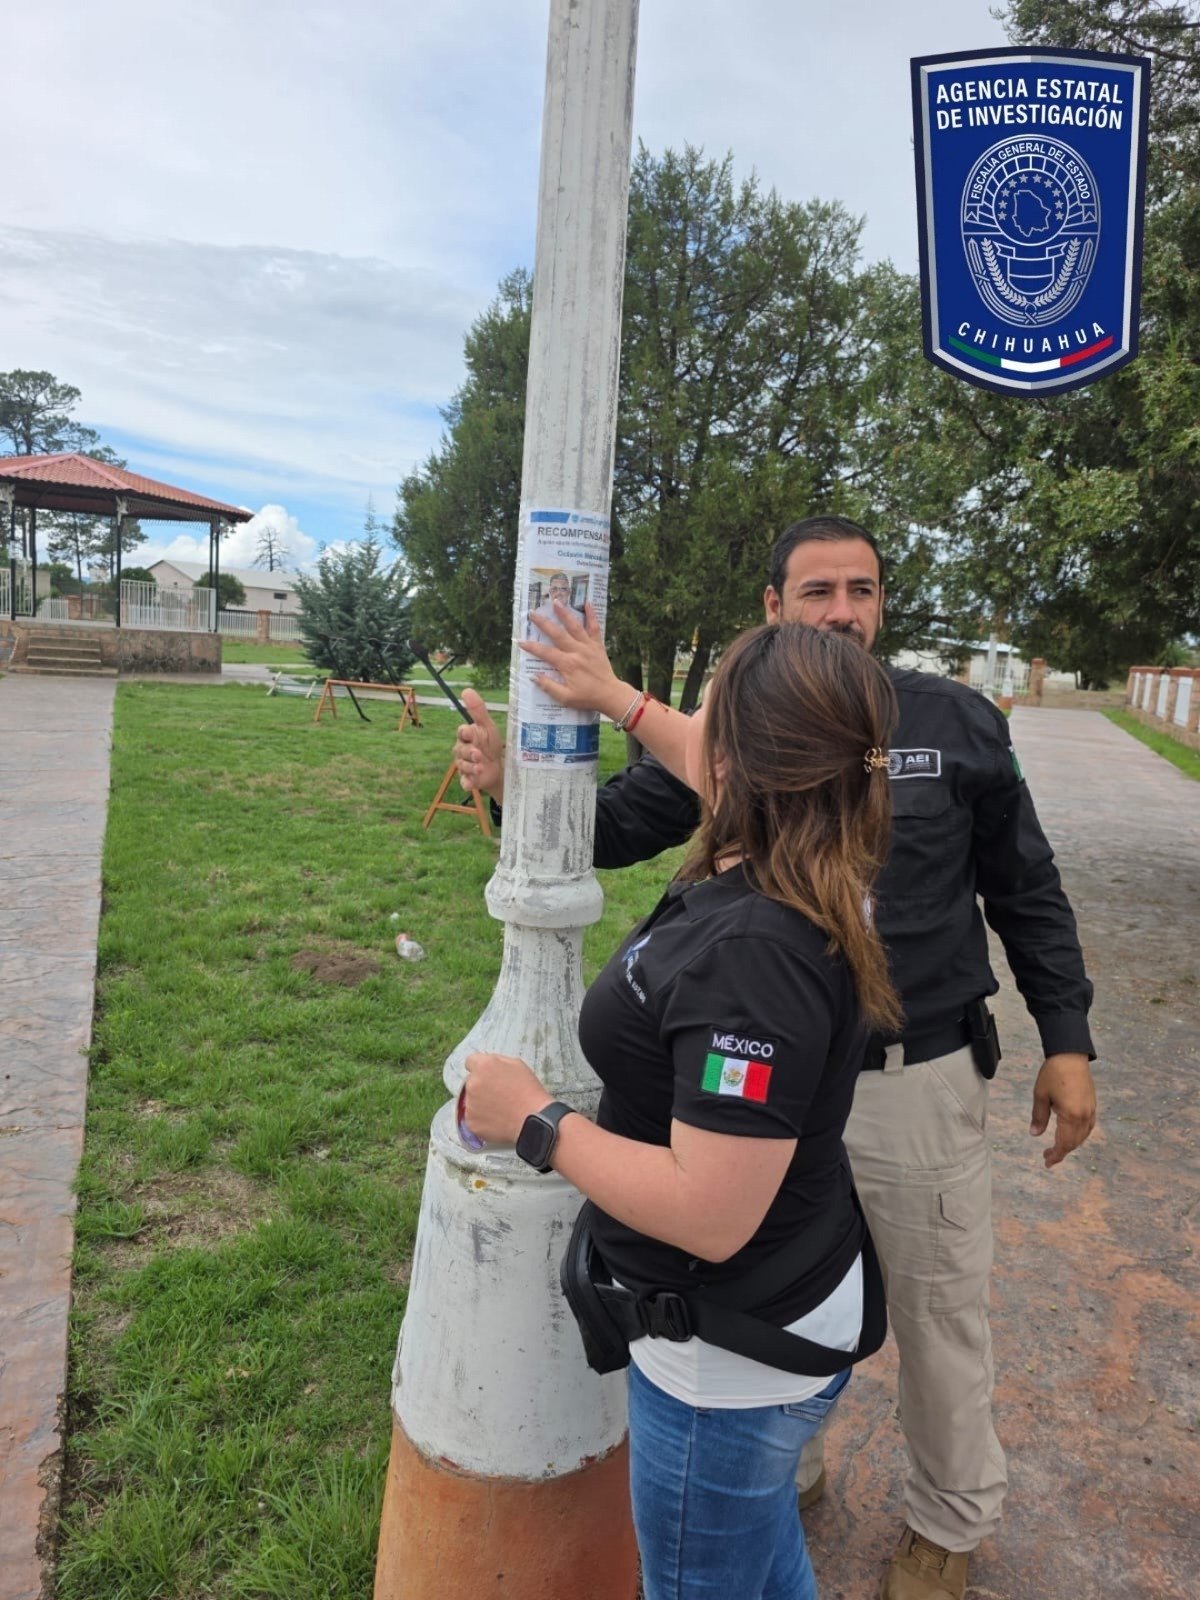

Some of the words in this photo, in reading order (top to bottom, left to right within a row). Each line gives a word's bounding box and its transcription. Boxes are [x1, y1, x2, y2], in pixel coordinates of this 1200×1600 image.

[537, 526, 603, 541] RECOMPENSA
[905, 754, 930, 764] AEI
[711, 1033, 774, 1058] MÉXICO
